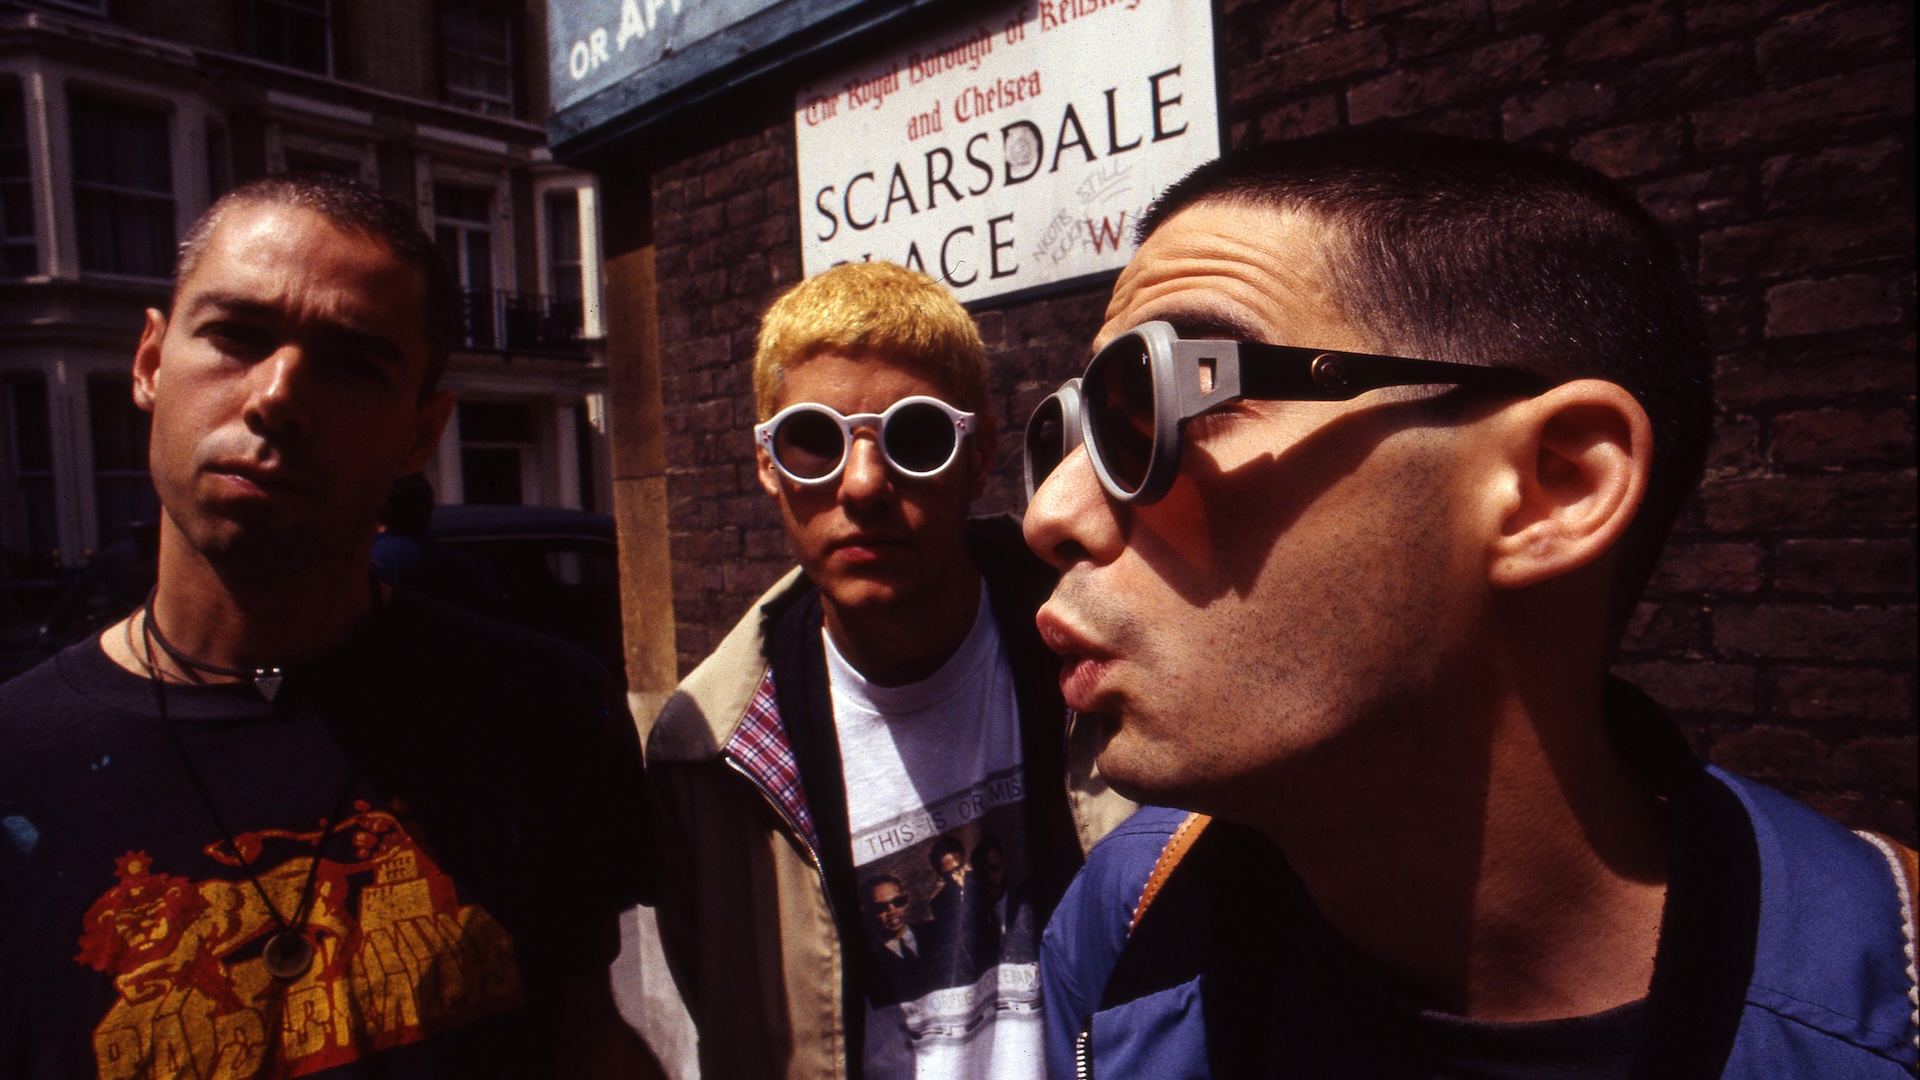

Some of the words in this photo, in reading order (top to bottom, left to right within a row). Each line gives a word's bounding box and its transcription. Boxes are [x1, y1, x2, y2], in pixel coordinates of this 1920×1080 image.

[569, 27, 610, 80] OR
[805, 92, 840, 127] The
[846, 61, 900, 110] Royal
[907, 27, 993, 85] Borough
[1004, 8, 1026, 46] of
[907, 100, 943, 141] and
[954, 69, 1042, 123] Chelsea
[816, 64, 1190, 242] SCARSDALE
[831, 212, 1019, 288] ACE
[864, 823, 914, 855] THIS
[926, 811, 947, 833] IS
